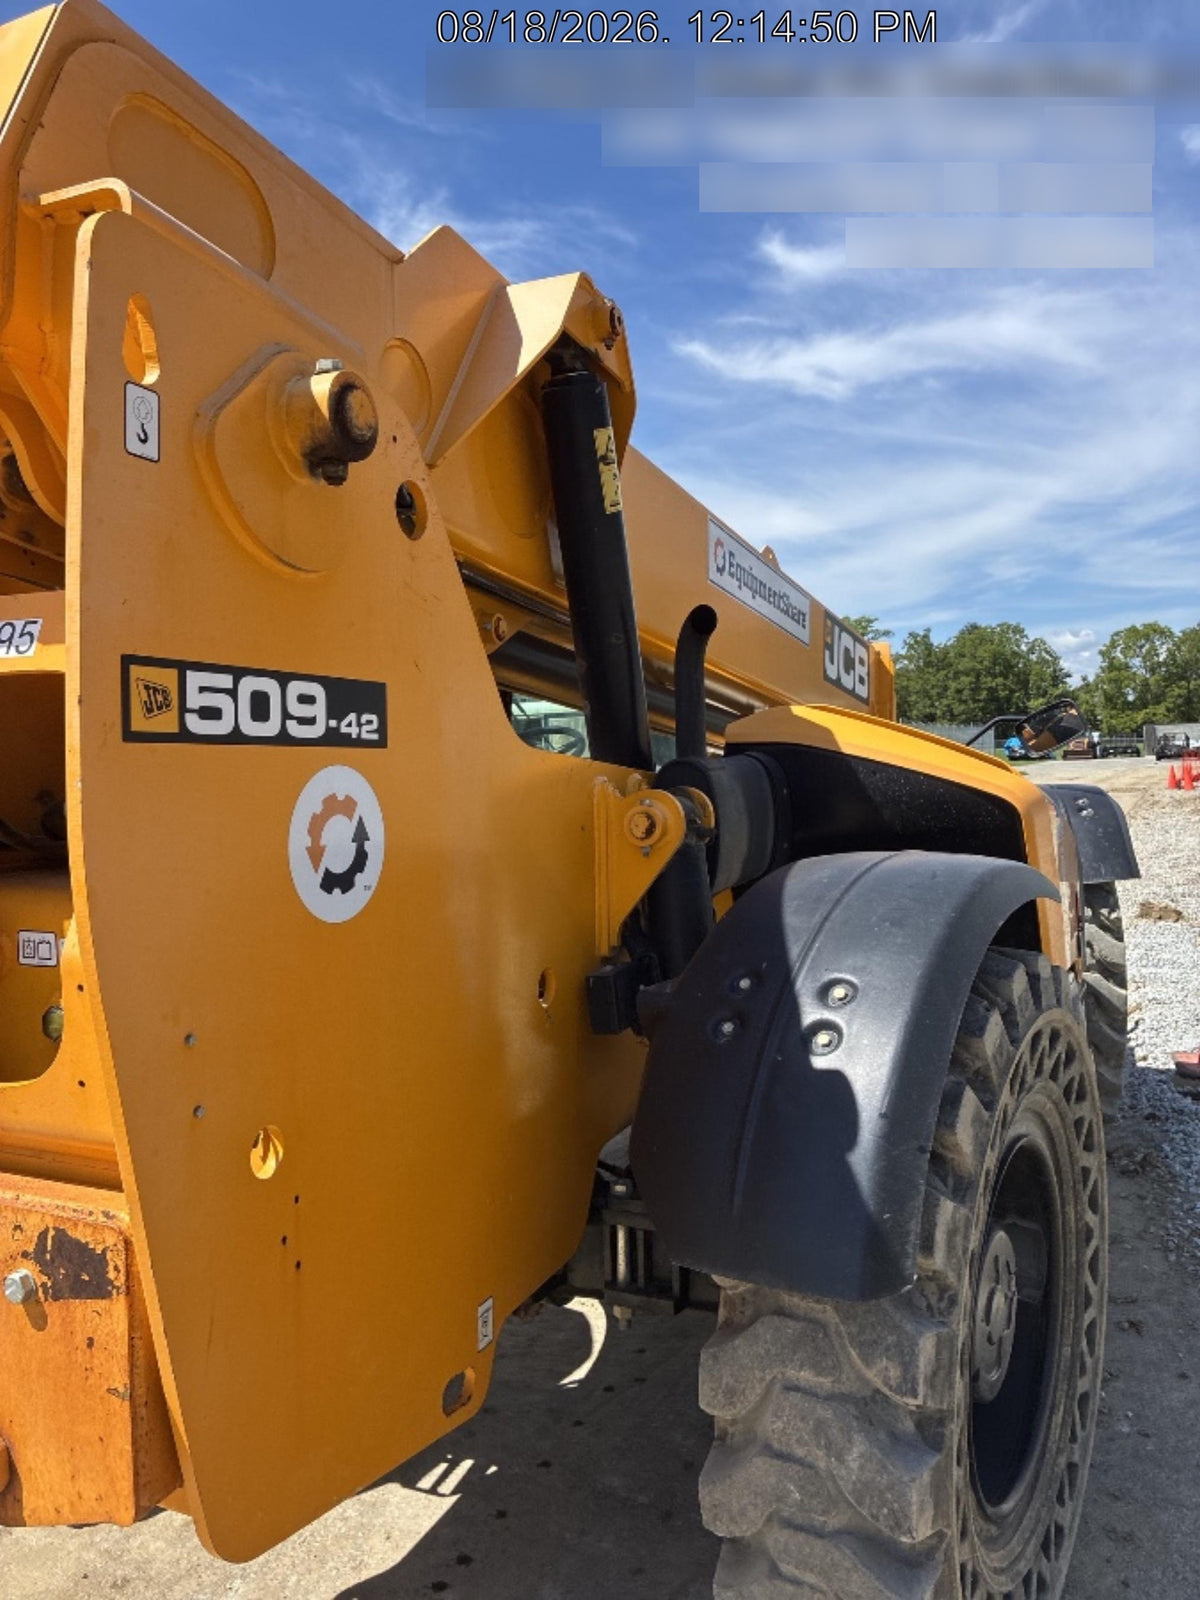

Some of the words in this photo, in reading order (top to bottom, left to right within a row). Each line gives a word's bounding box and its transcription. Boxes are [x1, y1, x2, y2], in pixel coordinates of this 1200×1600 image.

[728, 550, 806, 630] EquipmentShare
[824, 622, 869, 699] JCB
[184, 670, 380, 740] 509-42
